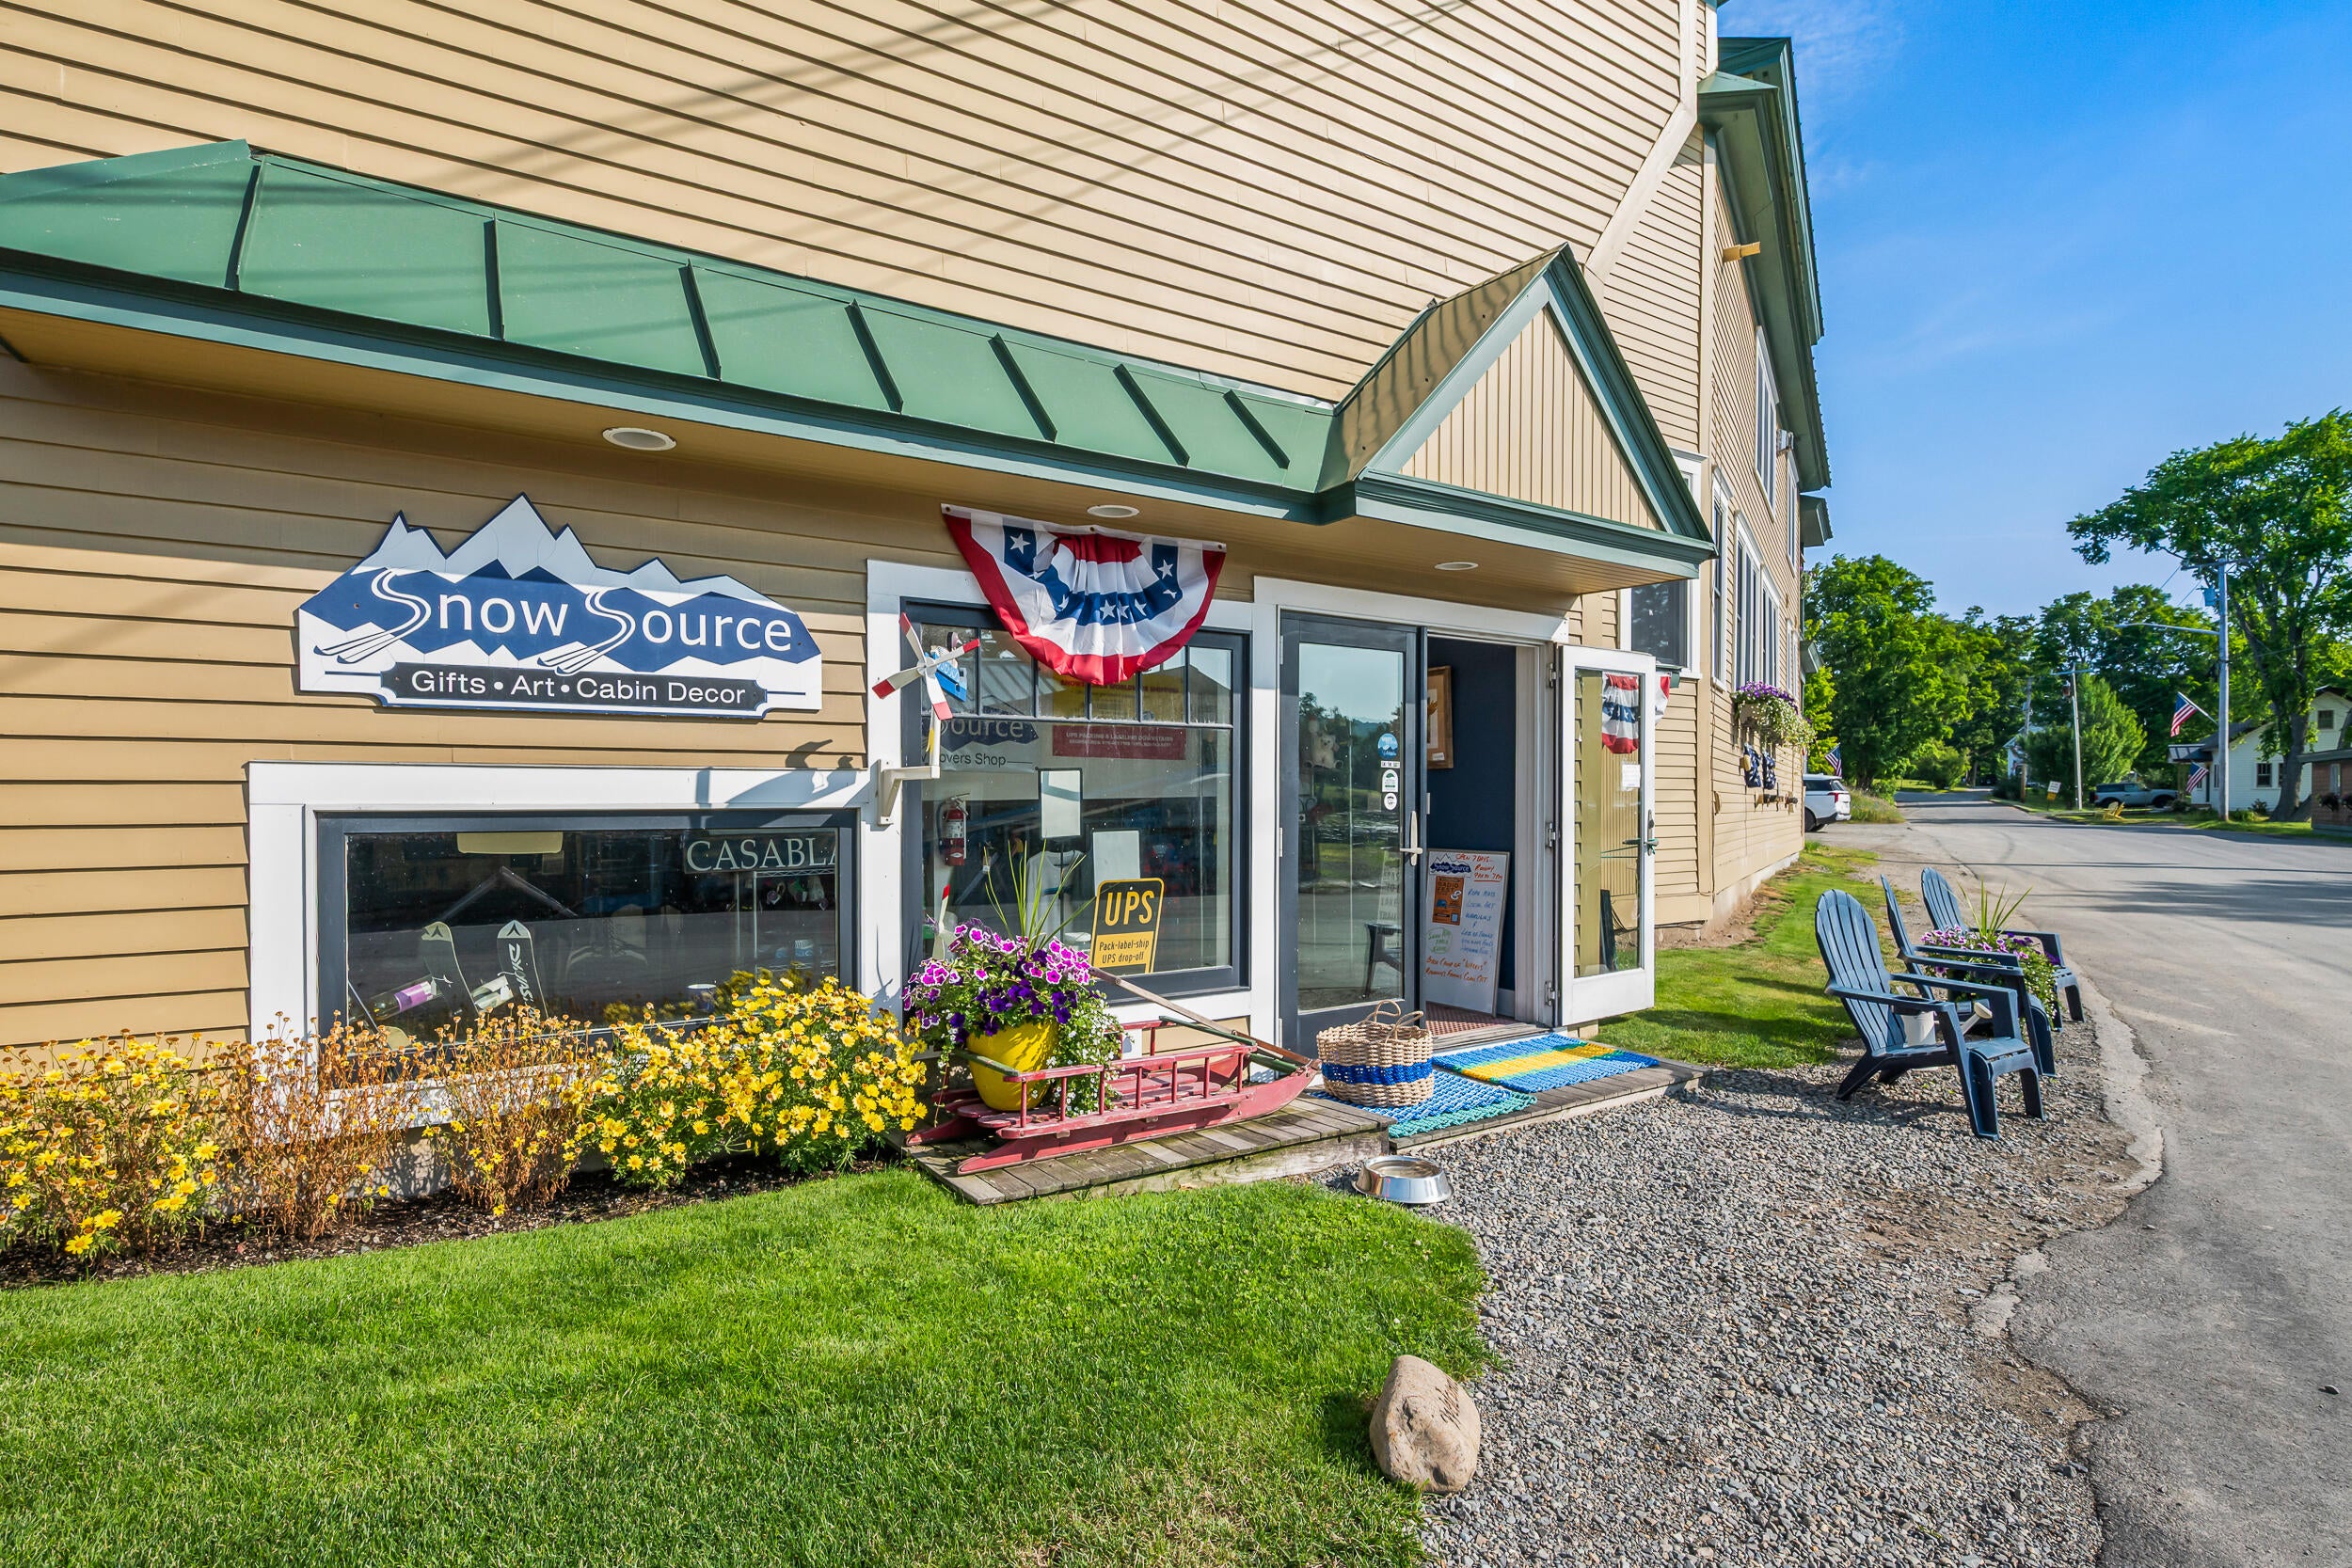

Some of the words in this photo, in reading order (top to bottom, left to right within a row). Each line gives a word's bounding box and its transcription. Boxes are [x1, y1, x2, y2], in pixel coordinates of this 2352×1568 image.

[318, 568, 568, 662] Snow
[540, 589, 793, 672] Source
[411, 670, 486, 694] Gifts
[510, 674, 555, 698] Art
[575, 677, 658, 702] Cabin
[667, 680, 747, 705] Decor
[940, 720, 1024, 738] ource
[940, 753, 972, 765] overs
[975, 752, 1007, 768] Shop
[1104, 890, 1155, 927] UPS
[1099, 939, 1150, 952] Pack-label-ship
[1102, 953, 1117, 964] UPS
[1118, 951, 1144, 963] drop-off
